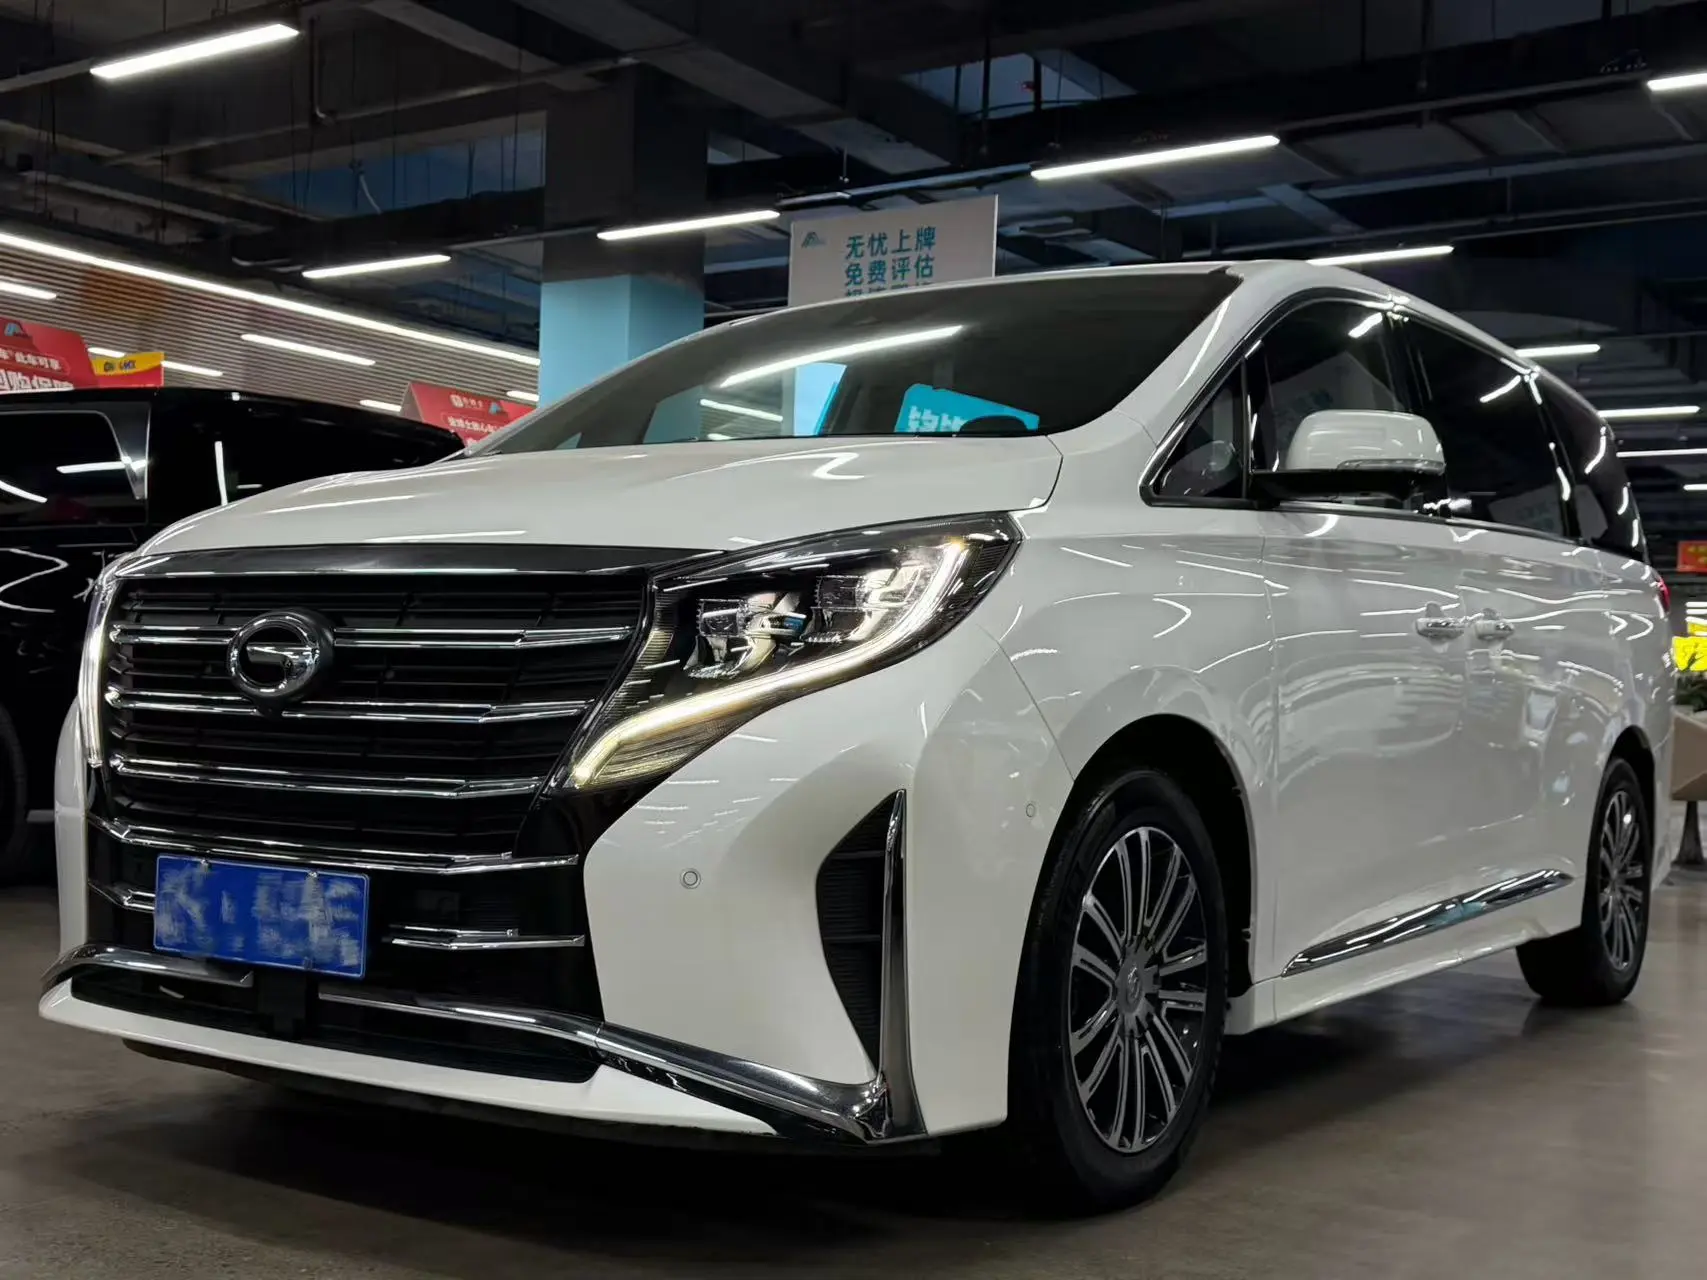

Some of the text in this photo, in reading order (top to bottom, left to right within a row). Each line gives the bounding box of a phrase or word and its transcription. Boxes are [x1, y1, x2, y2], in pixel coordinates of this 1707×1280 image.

[845, 226, 936, 260] 无忧上牌
[844, 254, 935, 286] 免费评估
